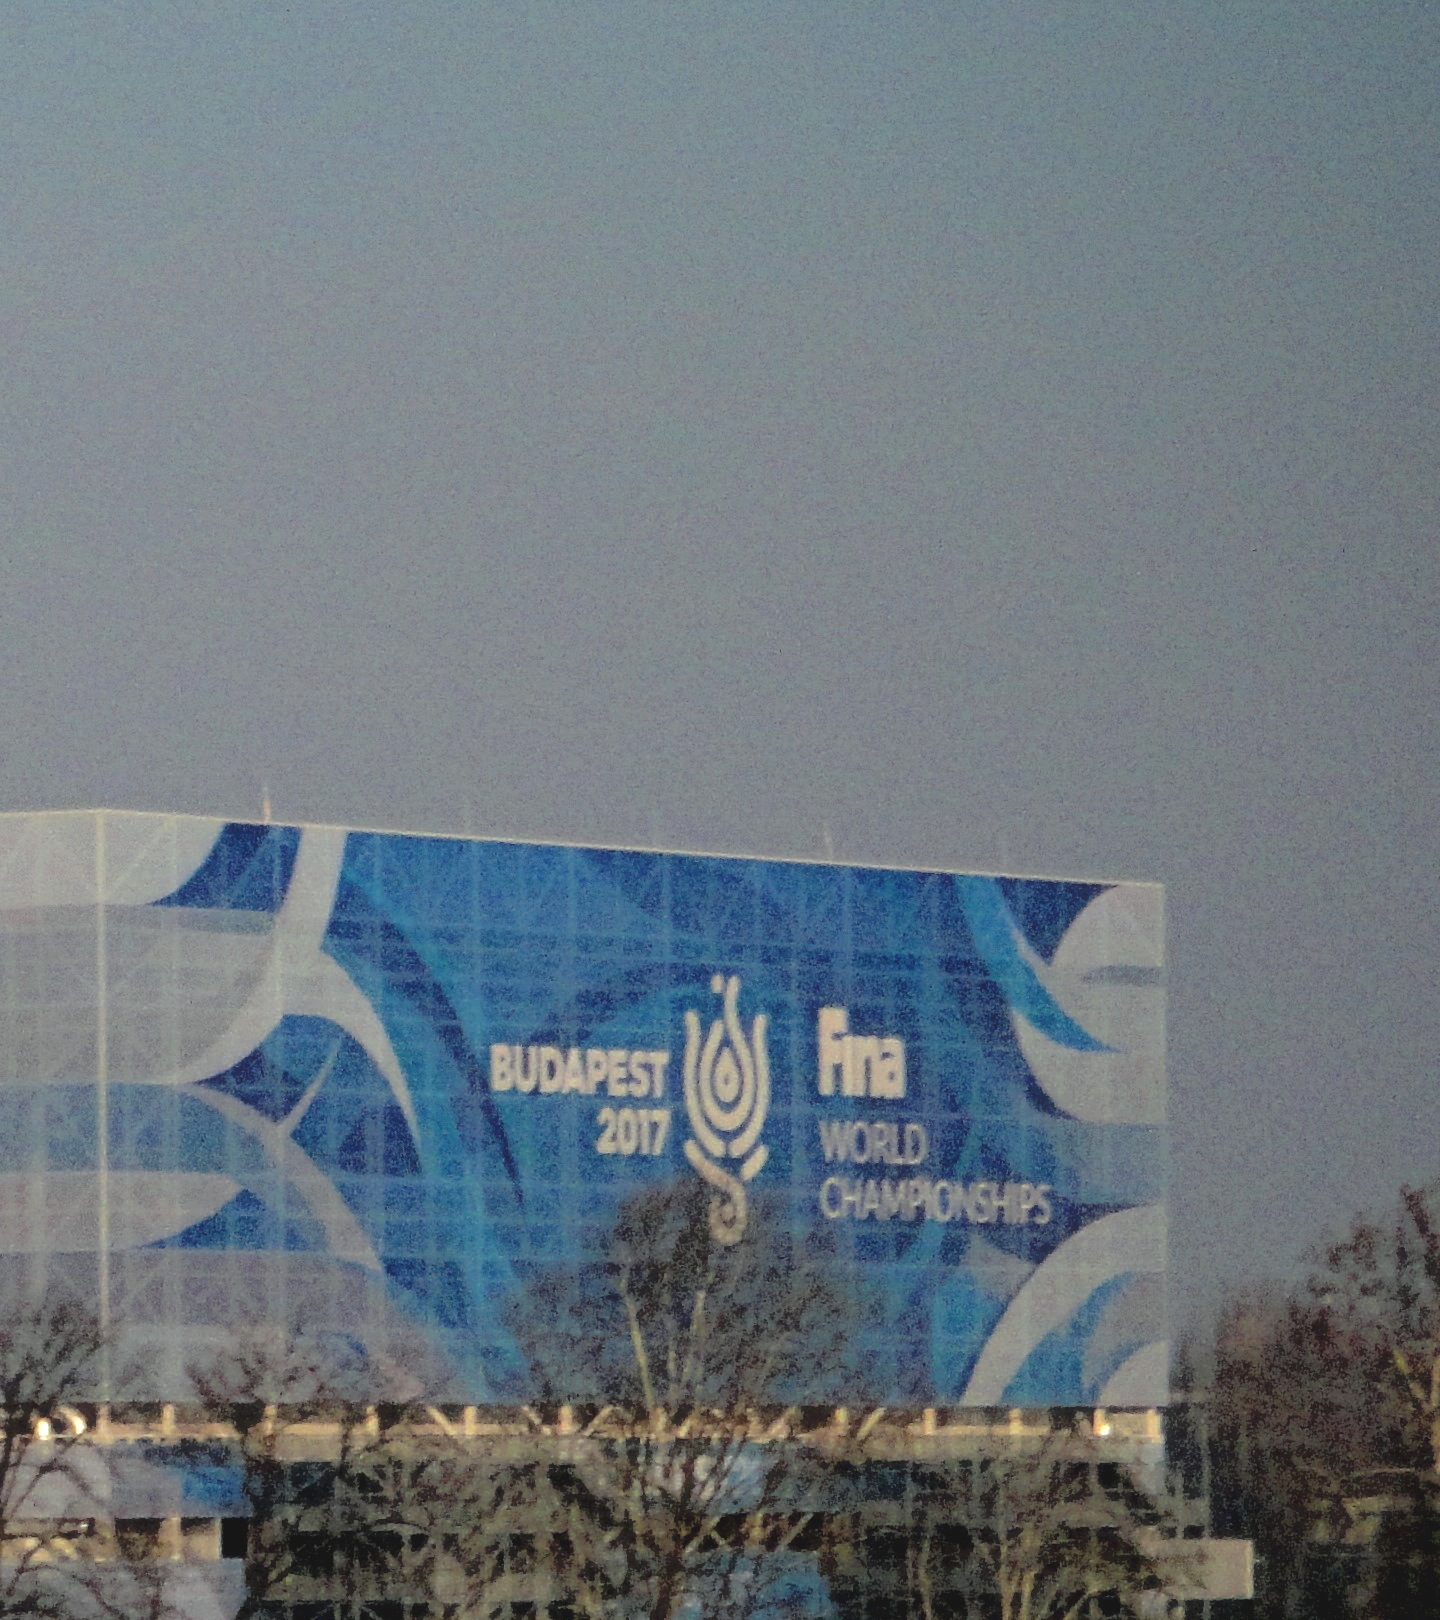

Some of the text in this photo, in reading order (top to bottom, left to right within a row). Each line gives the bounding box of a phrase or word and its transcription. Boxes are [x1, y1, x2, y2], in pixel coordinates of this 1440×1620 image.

[490, 1044, 669, 1098] BUDAPEST
[596, 1107, 669, 1155] 2017
[819, 1120, 928, 1165] WORLD
[821, 1175, 1051, 1225] CHAMPIONSHIPS
